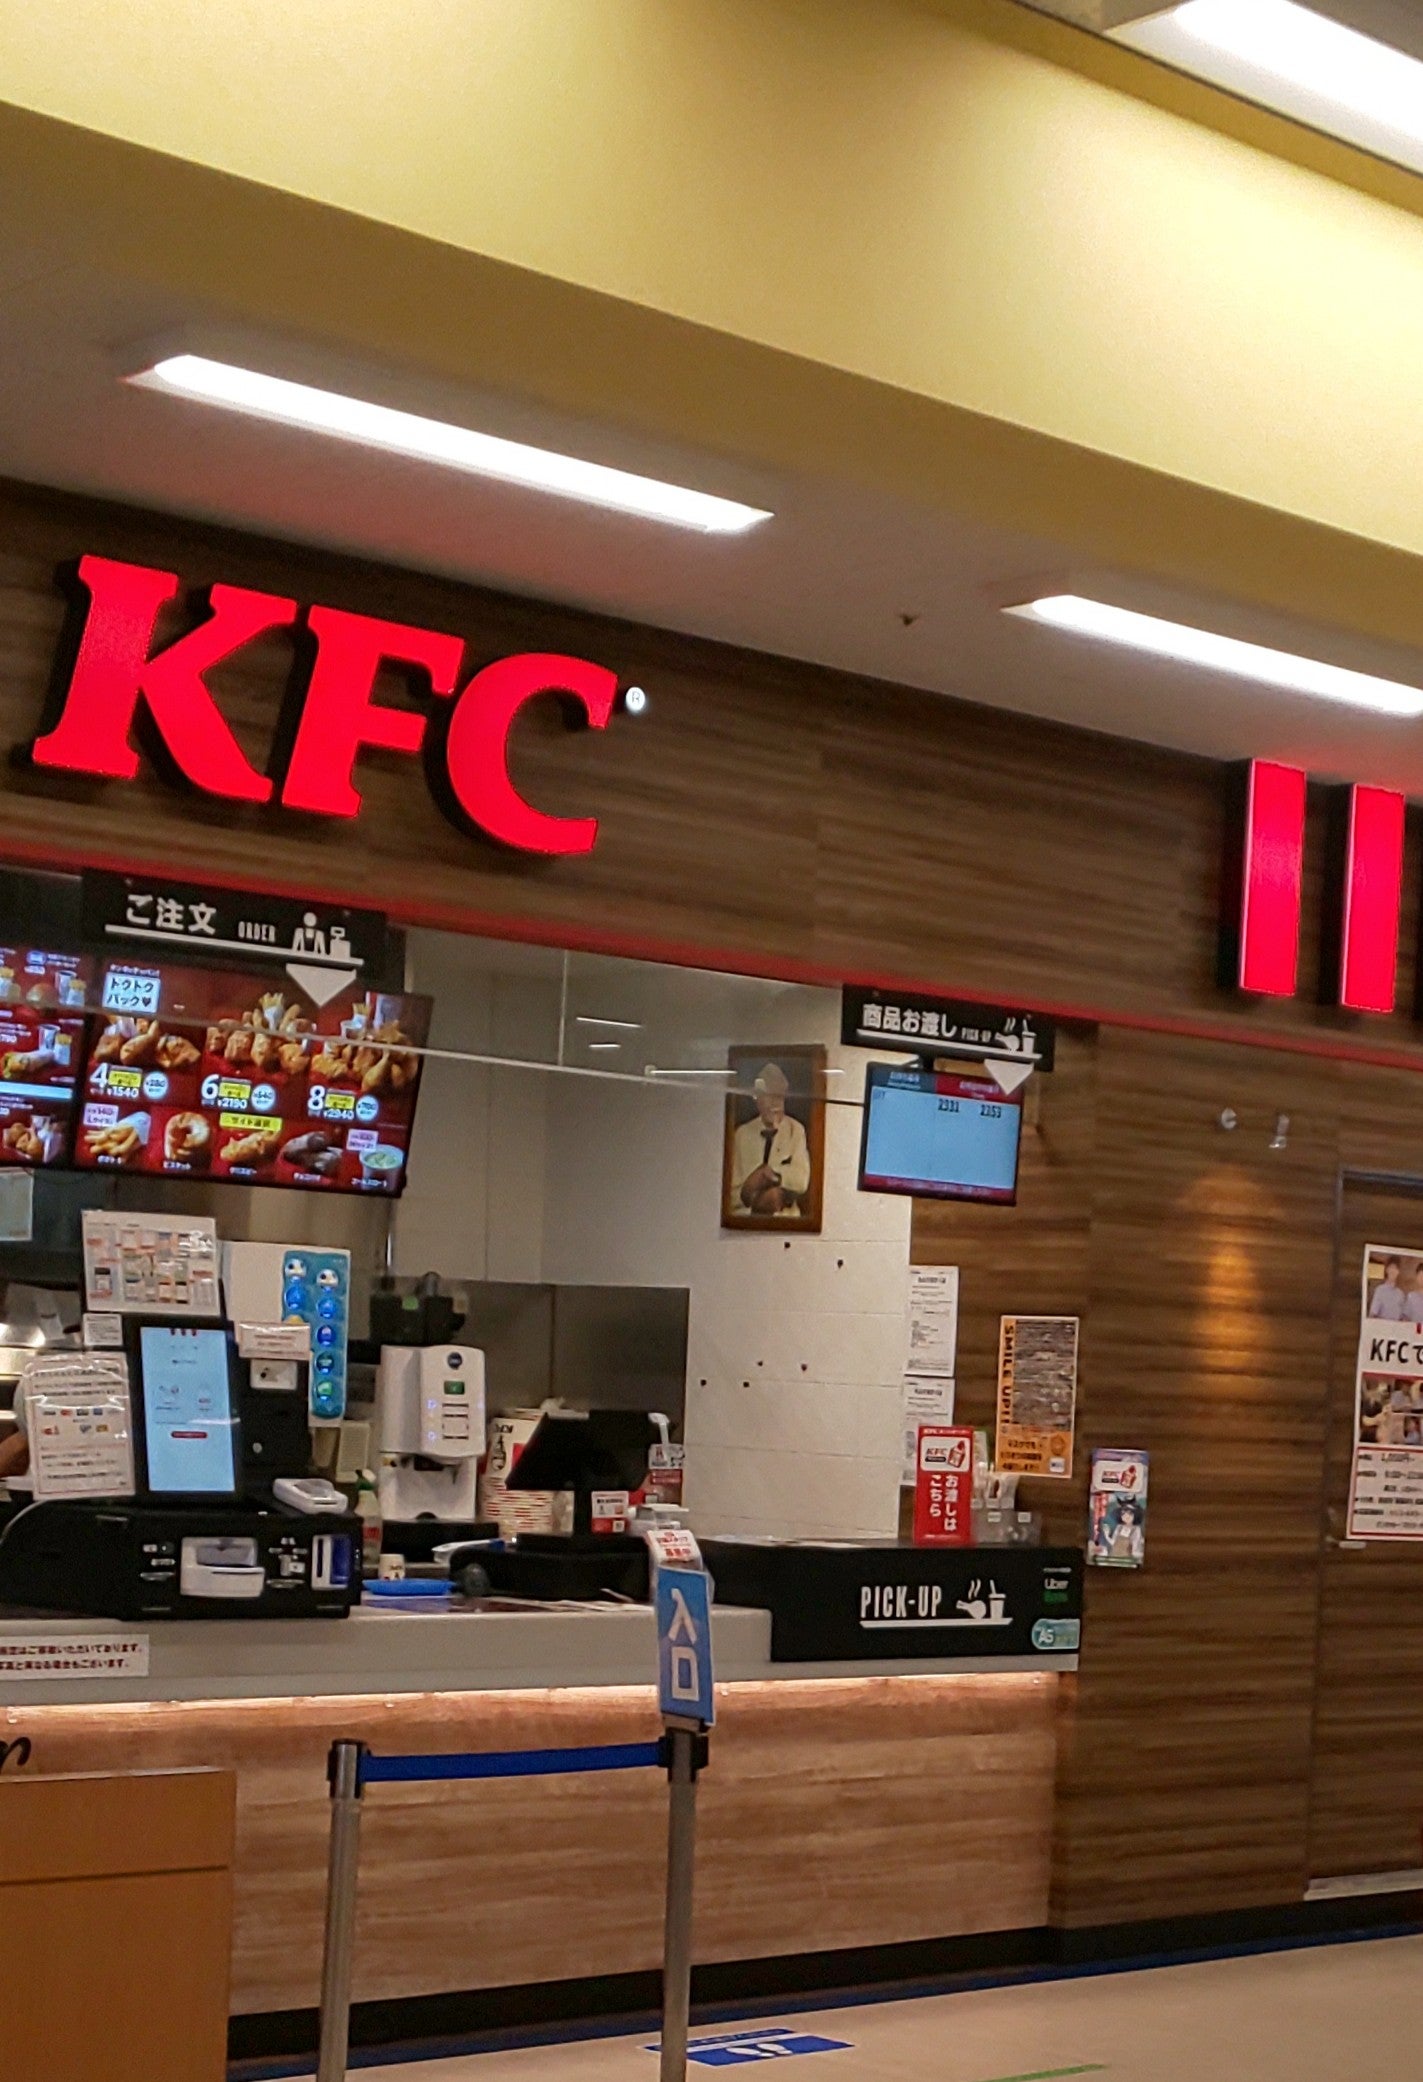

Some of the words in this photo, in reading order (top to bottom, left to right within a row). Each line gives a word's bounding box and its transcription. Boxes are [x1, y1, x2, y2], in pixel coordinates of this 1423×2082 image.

[32, 554, 619, 856] KFC
[126, 894, 217, 935] ご注文
[238, 920, 276, 943] ORDER
[110, 978, 155, 993] トクトク
[862, 1004, 956, 1037] 商品お渡し
[89, 1062, 108, 1088] 4
[201, 1074, 220, 1099] 6
[307, 1085, 326, 1111] 8
[930, 1474, 943, 1518] こちら
[944, 1474, 959, 1532] お渡しは
[861, 1585, 942, 1618] PICK-UP
[668, 1588, 700, 1701] 入口
